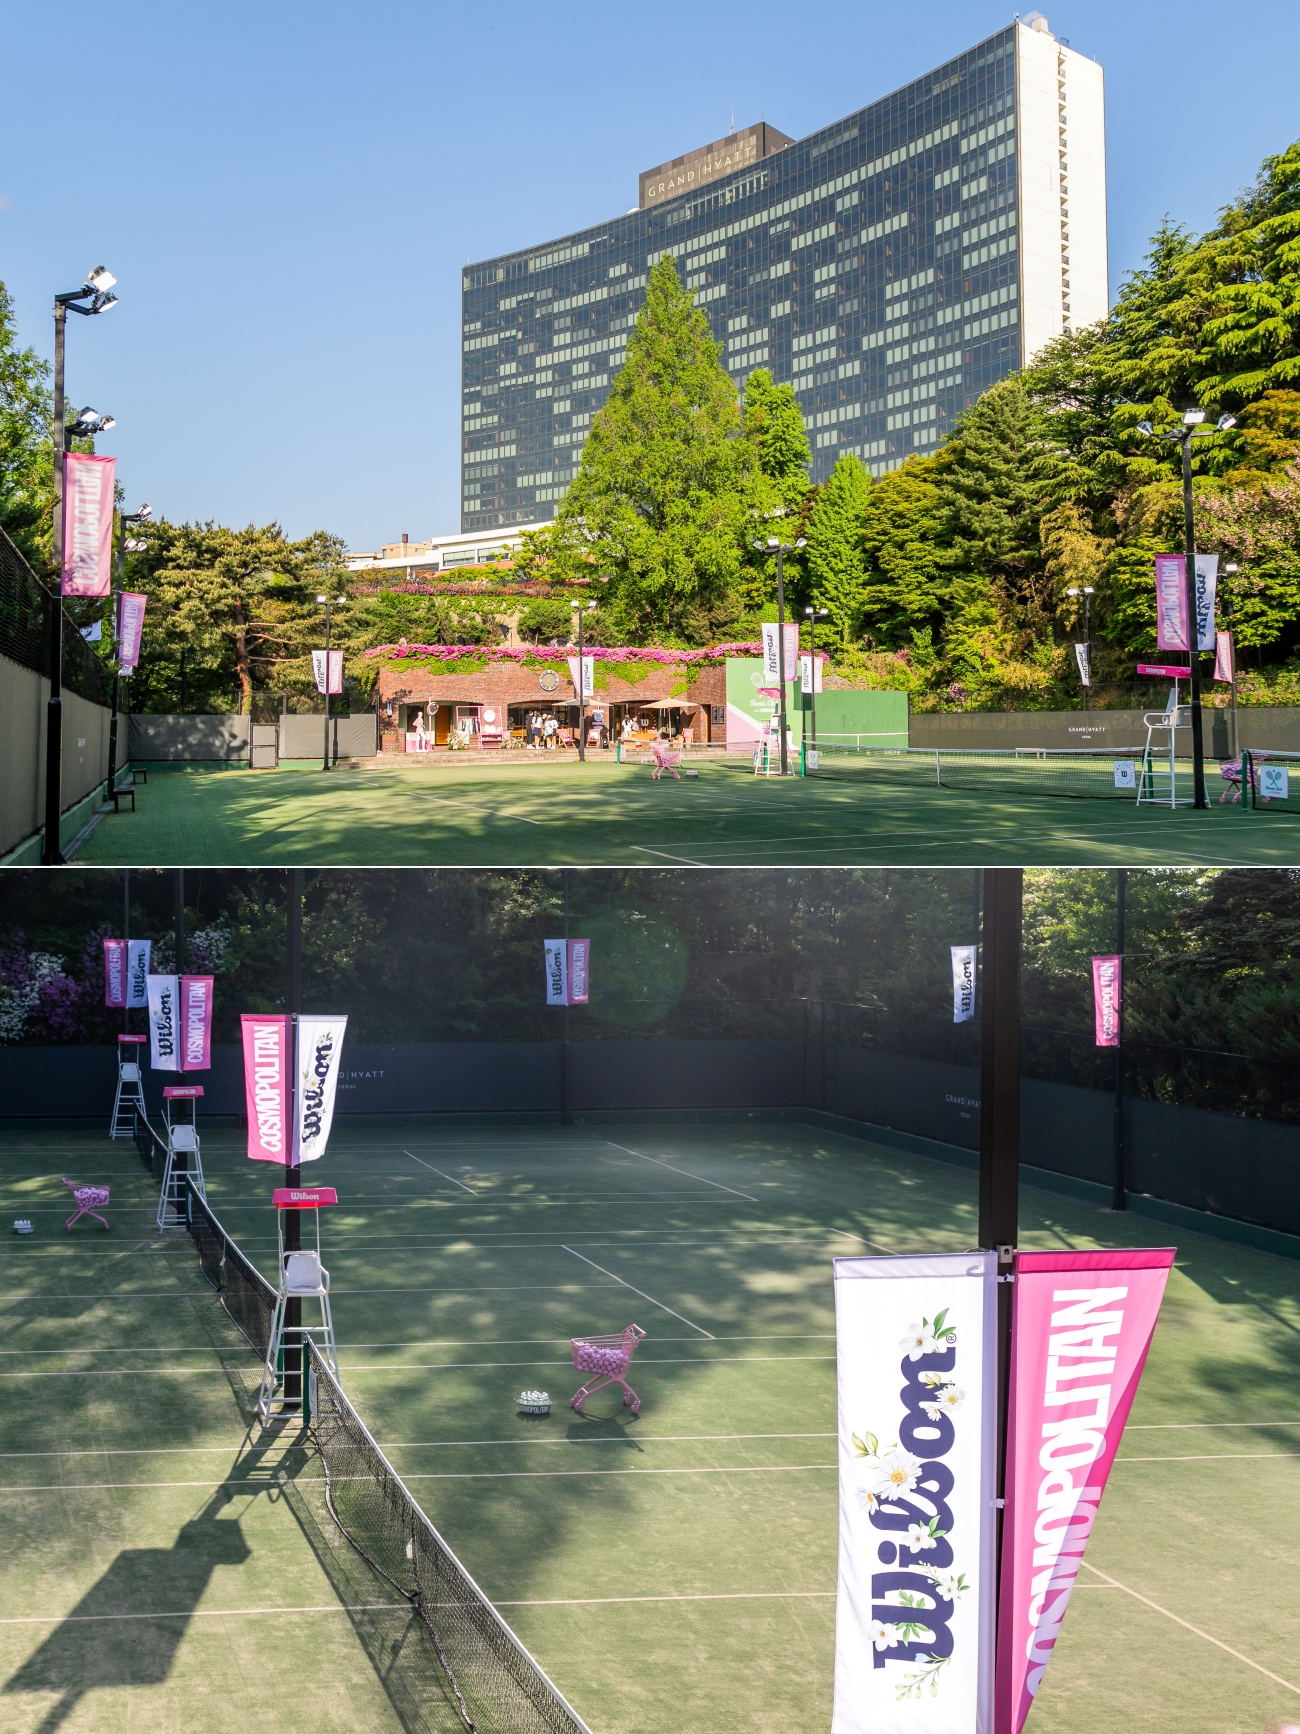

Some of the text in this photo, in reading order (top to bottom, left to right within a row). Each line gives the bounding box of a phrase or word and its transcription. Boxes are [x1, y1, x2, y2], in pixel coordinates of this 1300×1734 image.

[648, 147, 752, 197] GRAND HYATT
[109, 944, 122, 1003] COSMOPOLITAN
[133, 952, 146, 999] Wilson
[551, 951, 563, 997] Wilson
[572, 944, 585, 1000] COSMOPOLITAN
[961, 960, 972, 1014] Wilson
[1100, 962, 1114, 1039] COSMOPOLITAN
[157, 993, 173, 1058] Wilson
[187, 982, 206, 1063] COSMOPOLITAN
[253, 1025, 282, 1153] COSMOPOLITAN
[302, 1043, 333, 1144] Wilson
[946, 1094, 981, 1108] GRAND HYA
[290, 1192, 319, 1200] Wilson
[872, 1346, 955, 1669] Wilson
